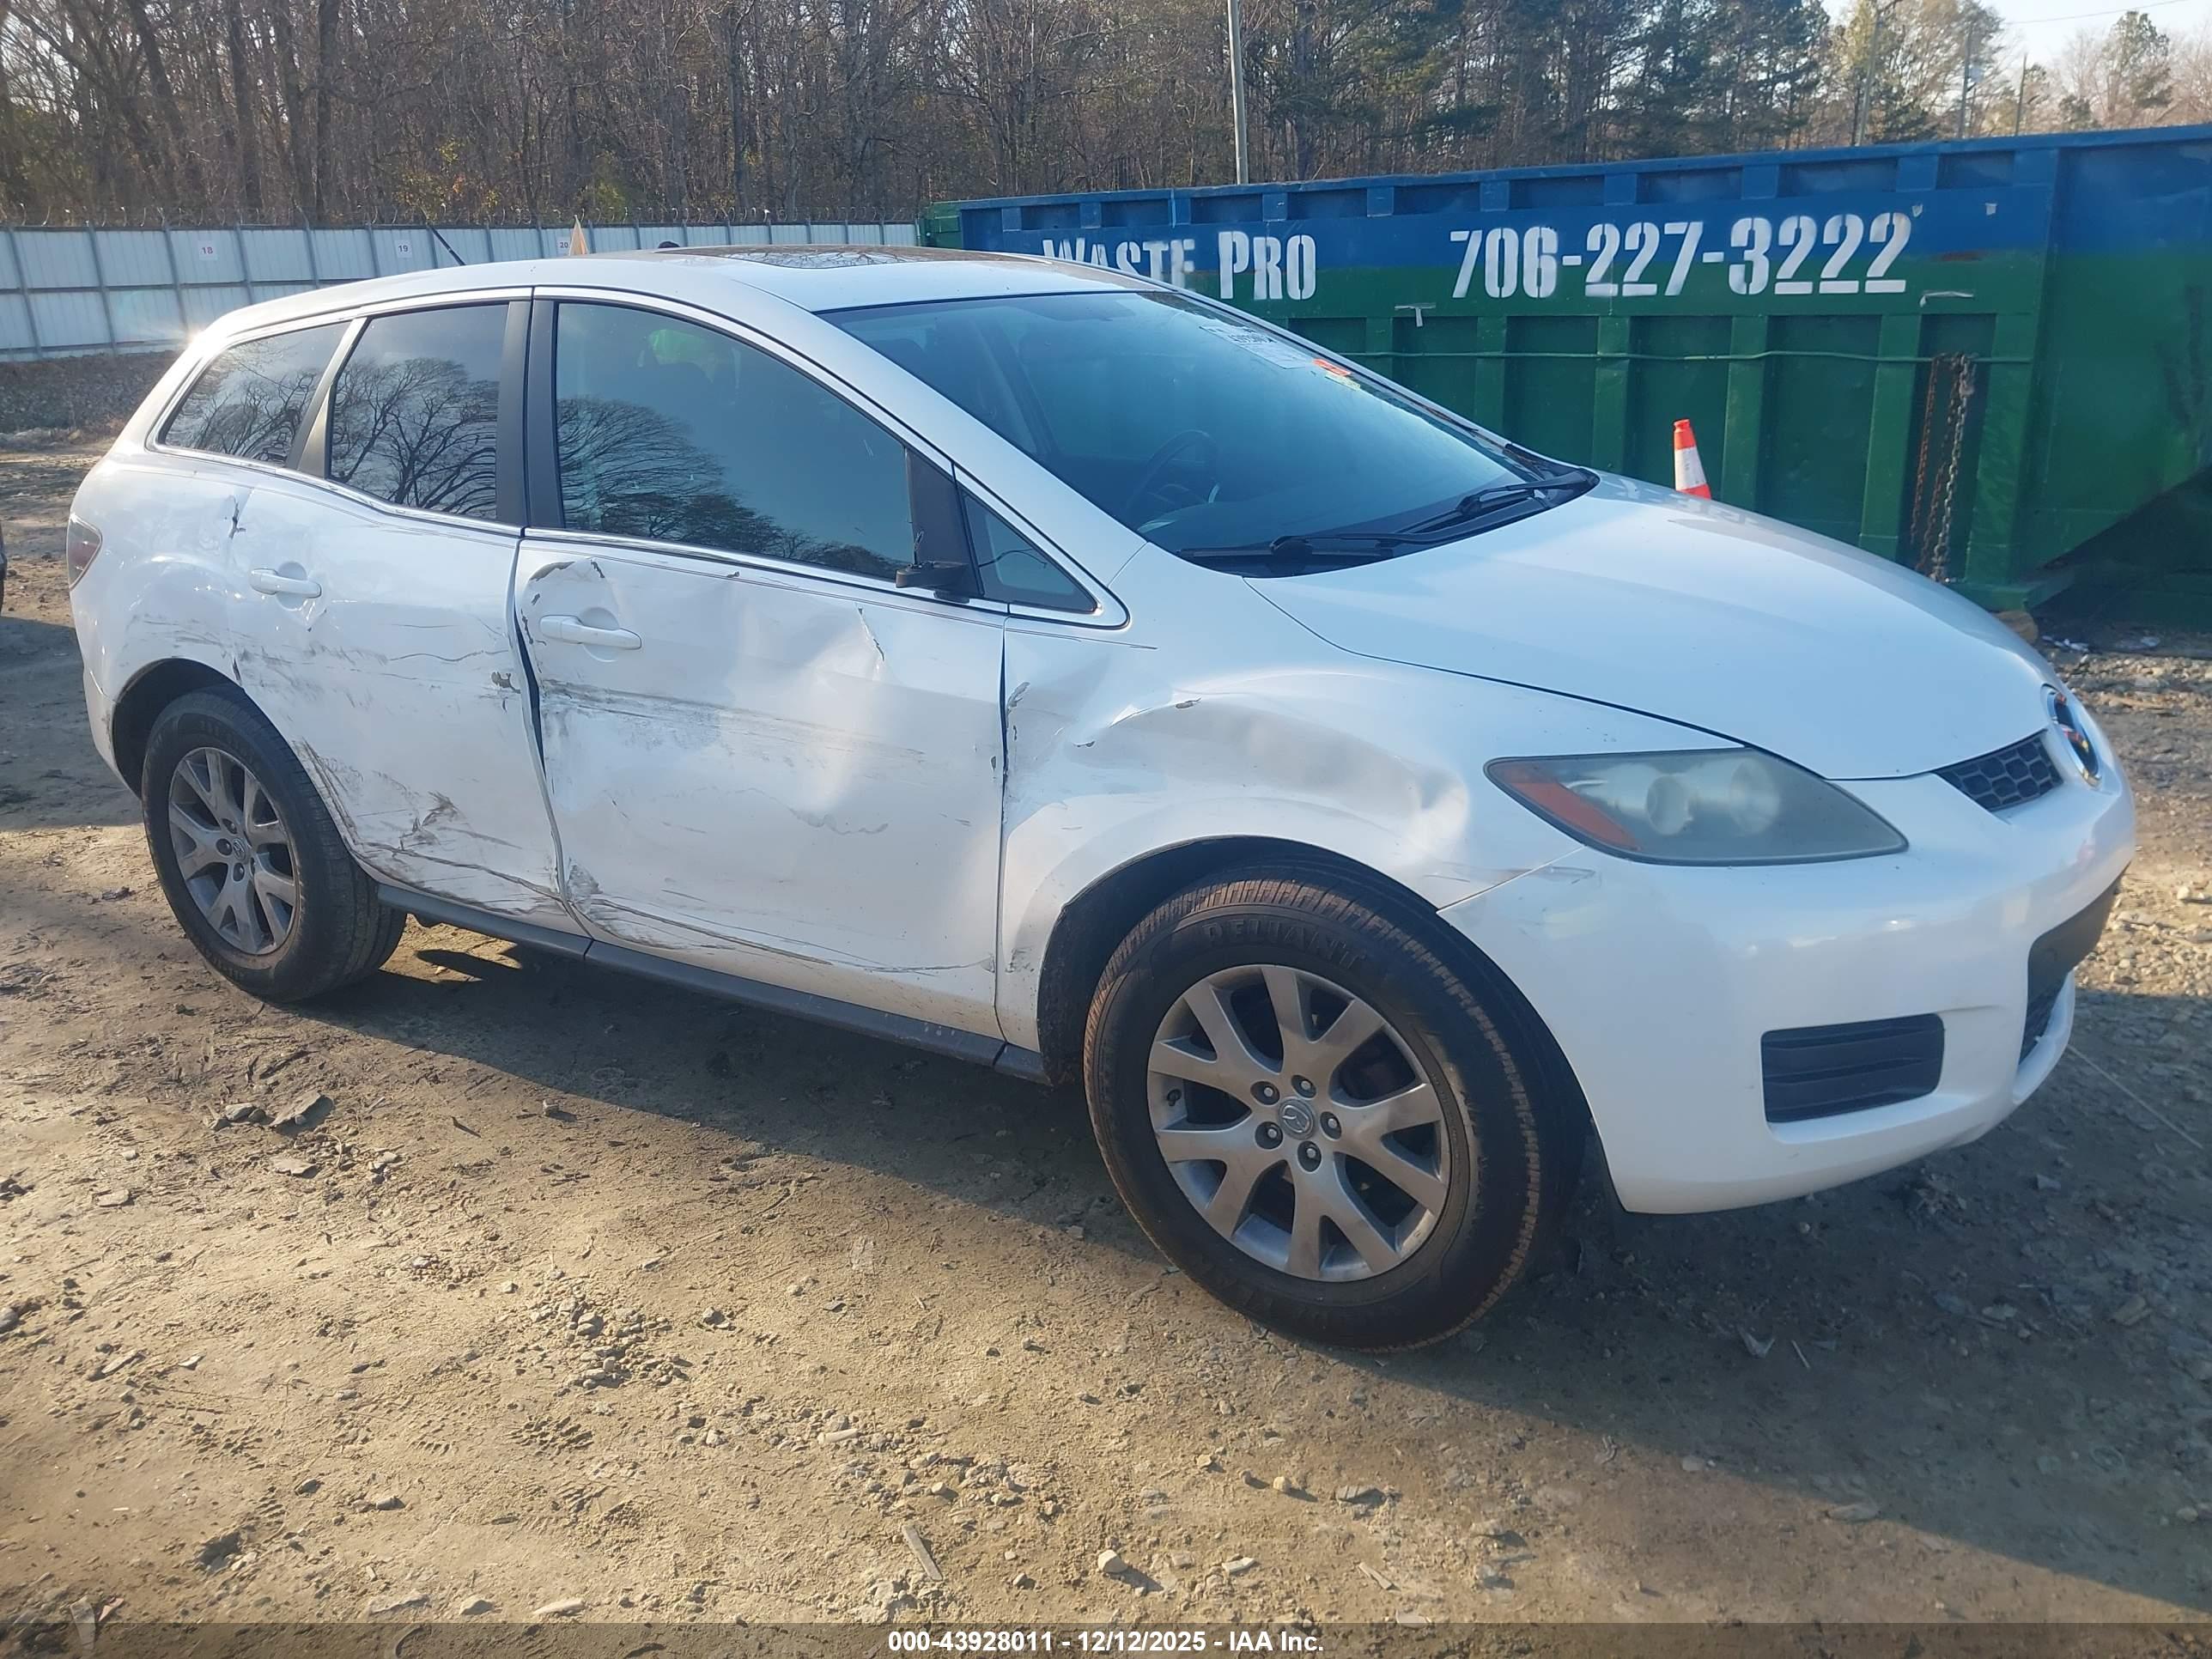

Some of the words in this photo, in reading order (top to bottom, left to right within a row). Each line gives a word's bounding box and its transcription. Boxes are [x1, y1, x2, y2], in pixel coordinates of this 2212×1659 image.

[202, 246, 214, 255] 18
[1218, 231, 1316, 301] PRO
[1450, 212, 1911, 299] 706-227-3222
